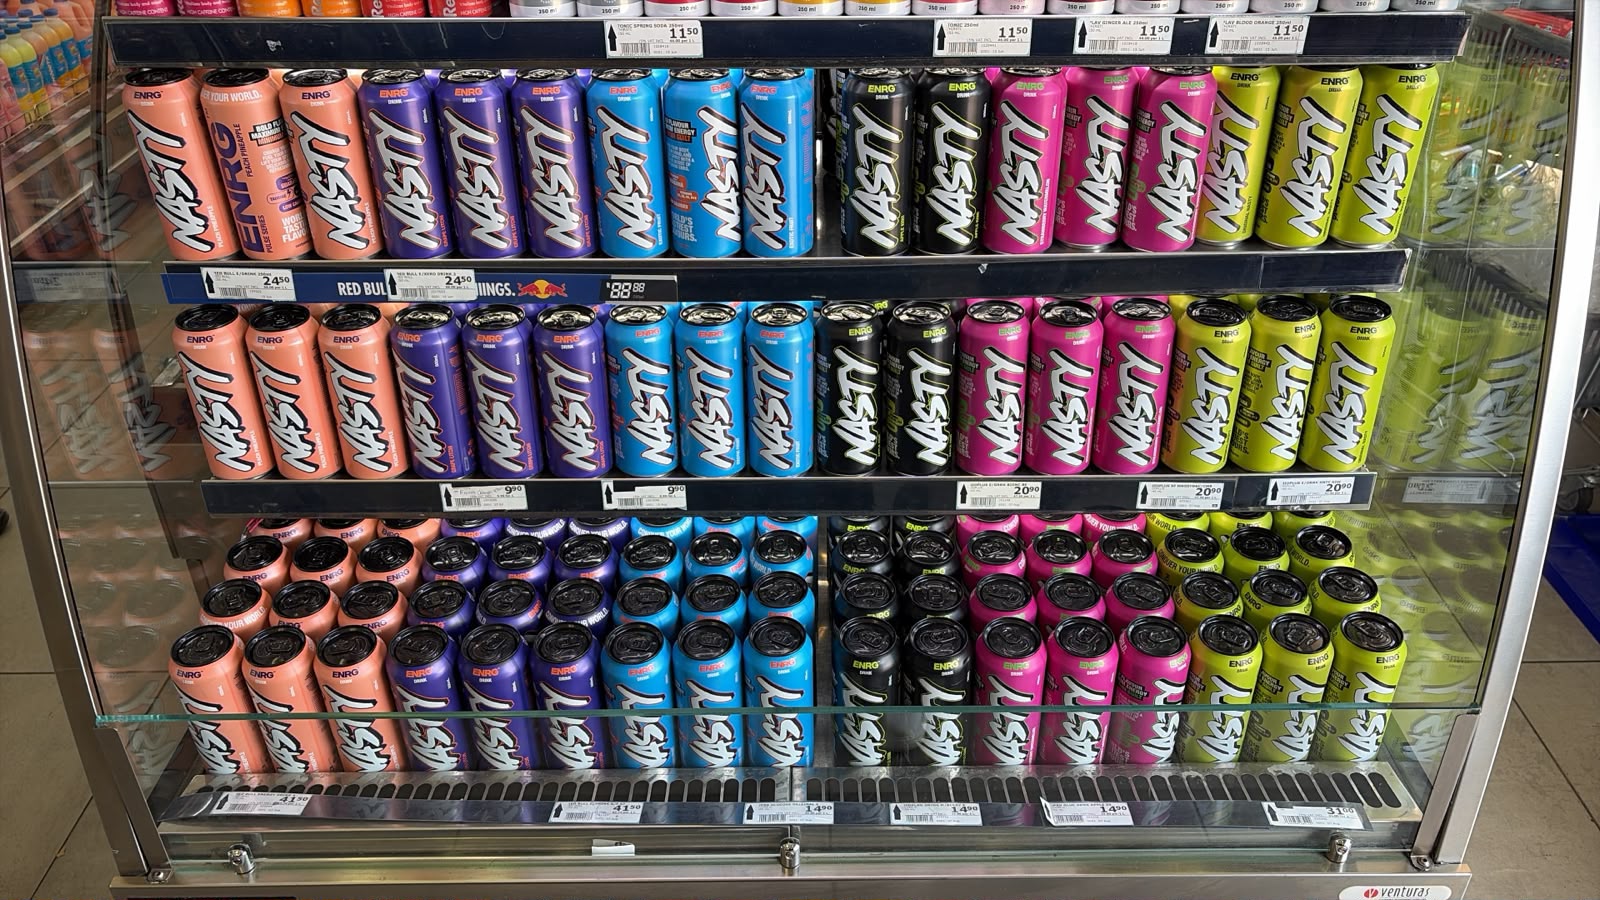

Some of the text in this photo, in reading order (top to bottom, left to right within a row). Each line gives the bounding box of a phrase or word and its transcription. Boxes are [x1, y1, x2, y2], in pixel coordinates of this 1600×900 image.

[868, 83, 896, 93] ENRG
[948, 82, 976, 92] ENRG
[1230, 72, 1259, 81] ENRG
[1321, 77, 1349, 86] ENRG
[1398, 74, 1427, 83] ENRG
[133, 91, 162, 99] ENRG
[210, 91, 229, 102] YOUR
[301, 90, 331, 100] ENRG
[379, 89, 409, 98] ENRG
[454, 87, 483, 96] ENRG
[532, 86, 561, 95] ENRG
[233, 123, 254, 178] PEACH PINEAPPLE
[1202, 90, 1259, 234] NASTY
[1352, 93, 1423, 235] NASTY
[369, 108, 441, 249] NASTY
[443, 106, 512, 249] NASTY
[520, 105, 585, 249] NASTY
[596, 105, 657, 250] NASTY
[697, 105, 742, 243] NASTY
[740, 102, 787, 250] NASTY
[850, 102, 904, 250] NASTY
[925, 101, 982, 247] NASTY
[992, 98, 1050, 246] NASTY
[1075, 95, 1132, 235] NASTY
[1147, 100, 1208, 242] NASTY
[1279, 95, 1348, 238] NASTY
[127, 109, 215, 252] NASTY
[210, 121, 265, 253] ENRG
[290, 110, 371, 250] NASTY
[257, 214, 273, 253] PULSE SERIES
[337, 282, 516, 297] RED BUL INGS.
[187, 335, 214, 344] ENRG
[257, 336, 284, 344] ENRG
[333, 335, 360, 344] ENRG
[397, 333, 421, 343] ENRG
[476, 334, 503, 343] ENRG
[553, 334, 580, 343] ENRG
[848, 327, 873, 337] ENRG
[922, 328, 947, 338] ENRG
[998, 326, 1022, 336] ENRG
[1214, 329, 1239, 338] ENRG
[1294, 323, 1316, 334] ENRG
[1350, 326, 1377, 334] ENRG
[178, 351, 255, 472] NASTY
[250, 351, 319, 473] NASTY
[324, 351, 393, 472] NASTY
[392, 347, 448, 474] NASTY
[467, 349, 527, 473] NASTY
[541, 350, 600, 472] NASTY
[622, 347, 675, 465] NASTY
[684, 347, 735, 469] NASTY
[750, 345, 794, 471] NASTY
[831, 345, 880, 467] NASTY
[904, 347, 952, 468] NASTY
[976, 346, 1025, 465] NASTY
[1040, 348, 1094, 467] NASTY
[1107, 341, 1164, 467] NASTY
[1181, 346, 1240, 465] NASTY
[1260, 343, 1315, 461] NASTY
[1315, 341, 1378, 465] NASTY
[472, 667, 499, 677] ENRG
[551, 666, 578, 675] ENRG
[853, 660, 879, 670] ENRG
[933, 659, 960, 671] ENRG
[1229, 657, 1253, 668] ENRG
[1307, 653, 1329, 666] ENRG
[1376, 653, 1399, 664] ENRG
[177, 669, 202, 678] ENRG
[250, 669, 274, 679] ENRG
[332, 668, 359, 679] ENRG
[406, 667, 433, 678] ENRG
[1381, 886, 1431, 898] venturas
